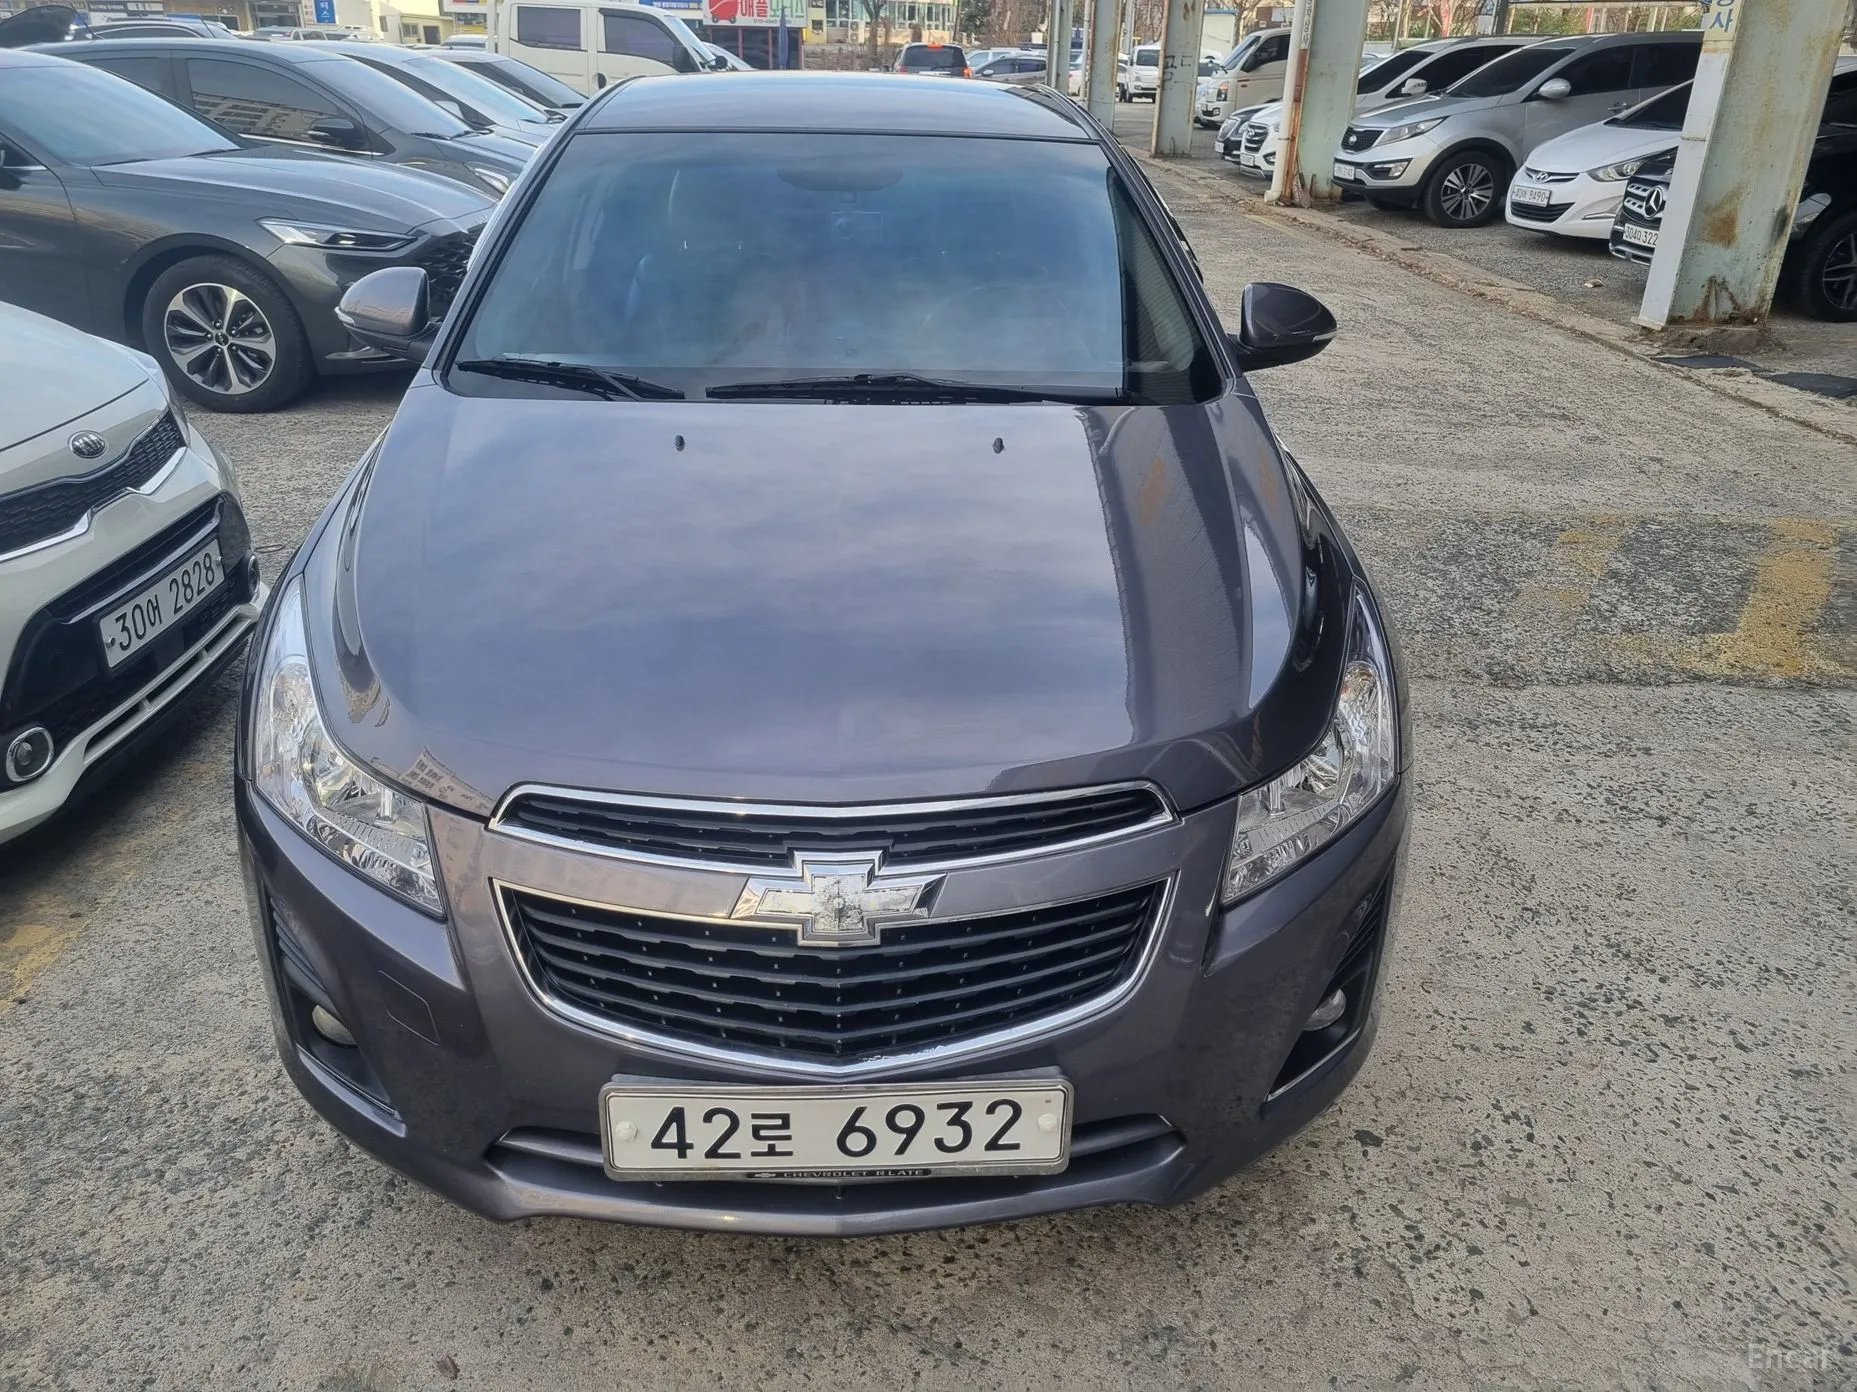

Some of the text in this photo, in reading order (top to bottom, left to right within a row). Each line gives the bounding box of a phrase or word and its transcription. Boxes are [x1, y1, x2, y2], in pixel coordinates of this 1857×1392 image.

[115, 552, 216, 652] 30어 2828
[651, 1098, 1022, 1160] 42로 6932
